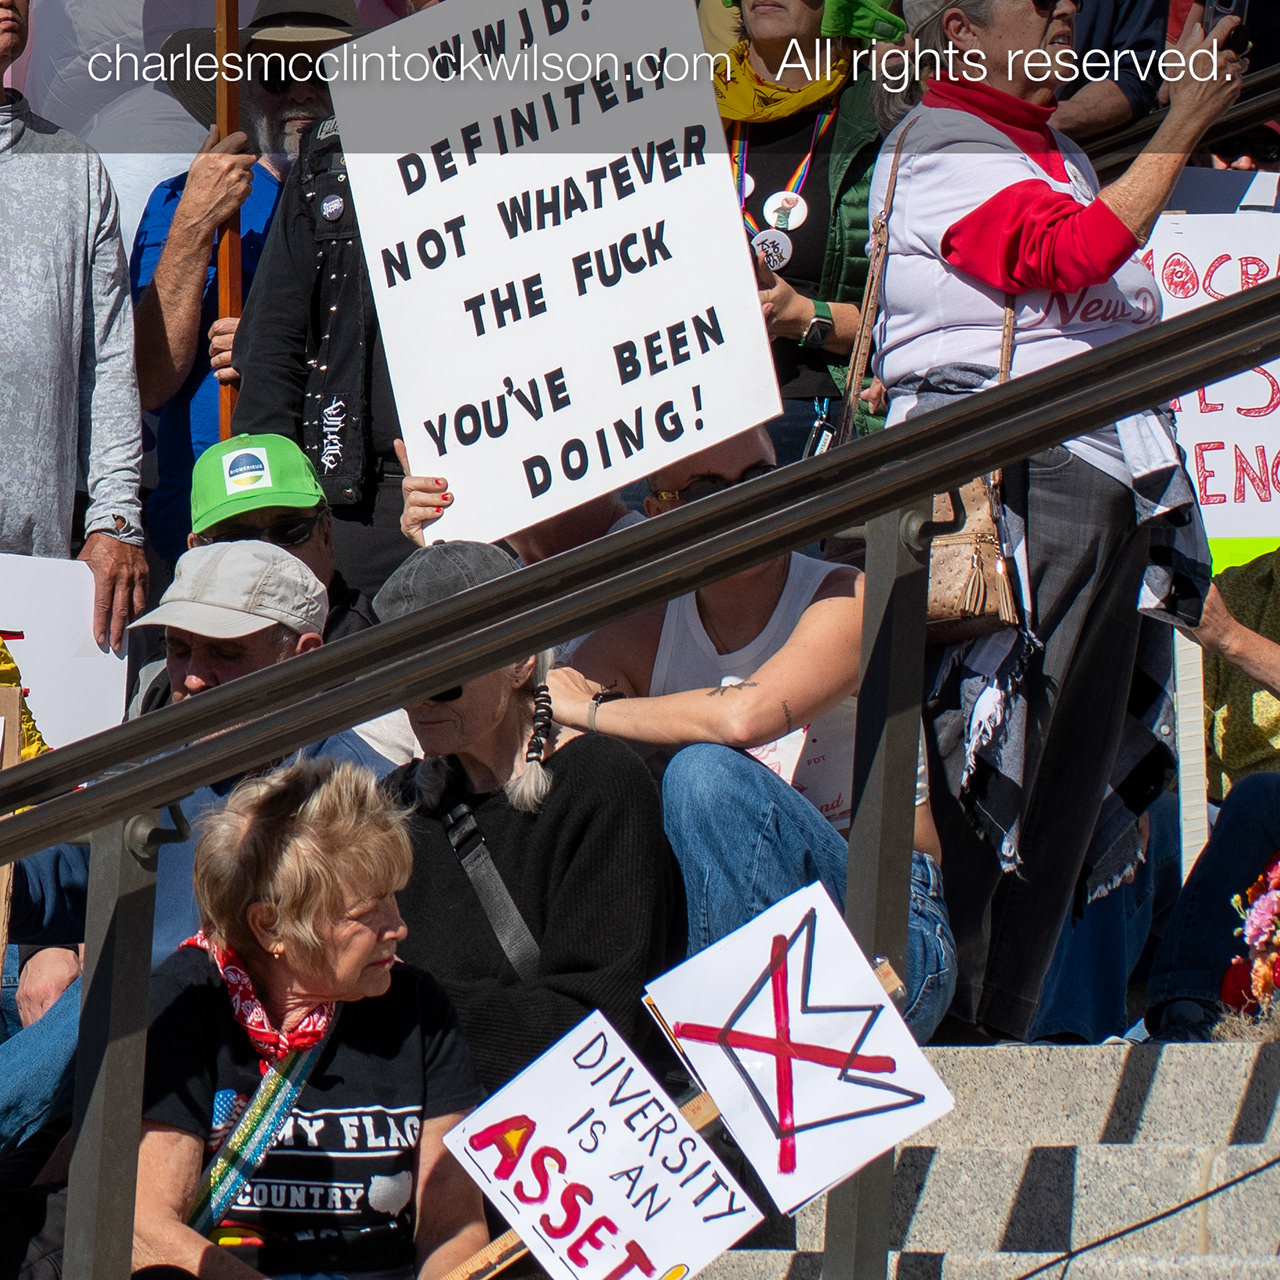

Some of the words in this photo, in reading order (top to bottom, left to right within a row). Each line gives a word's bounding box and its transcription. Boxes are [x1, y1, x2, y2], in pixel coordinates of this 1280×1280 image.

[397, 47, 669, 196] DEFINITELY
[381, 215, 466, 288] NOT
[497, 124, 707, 239] WHATEVER
[464, 273, 547, 336] THE
[572, 220, 673, 296] FUCK
[424, 367, 570, 457] YOU'VE
[613, 307, 725, 385] BEEN
[522, 385, 704, 499] DOING!
[339, 1115, 420, 1149] FLAG
[567, 1107, 607, 1154] IS
[609, 1165, 671, 1223] AN
[571, 1031, 746, 1224] DIVERSITY
[237, 1183, 364, 1210] COUNTRY
